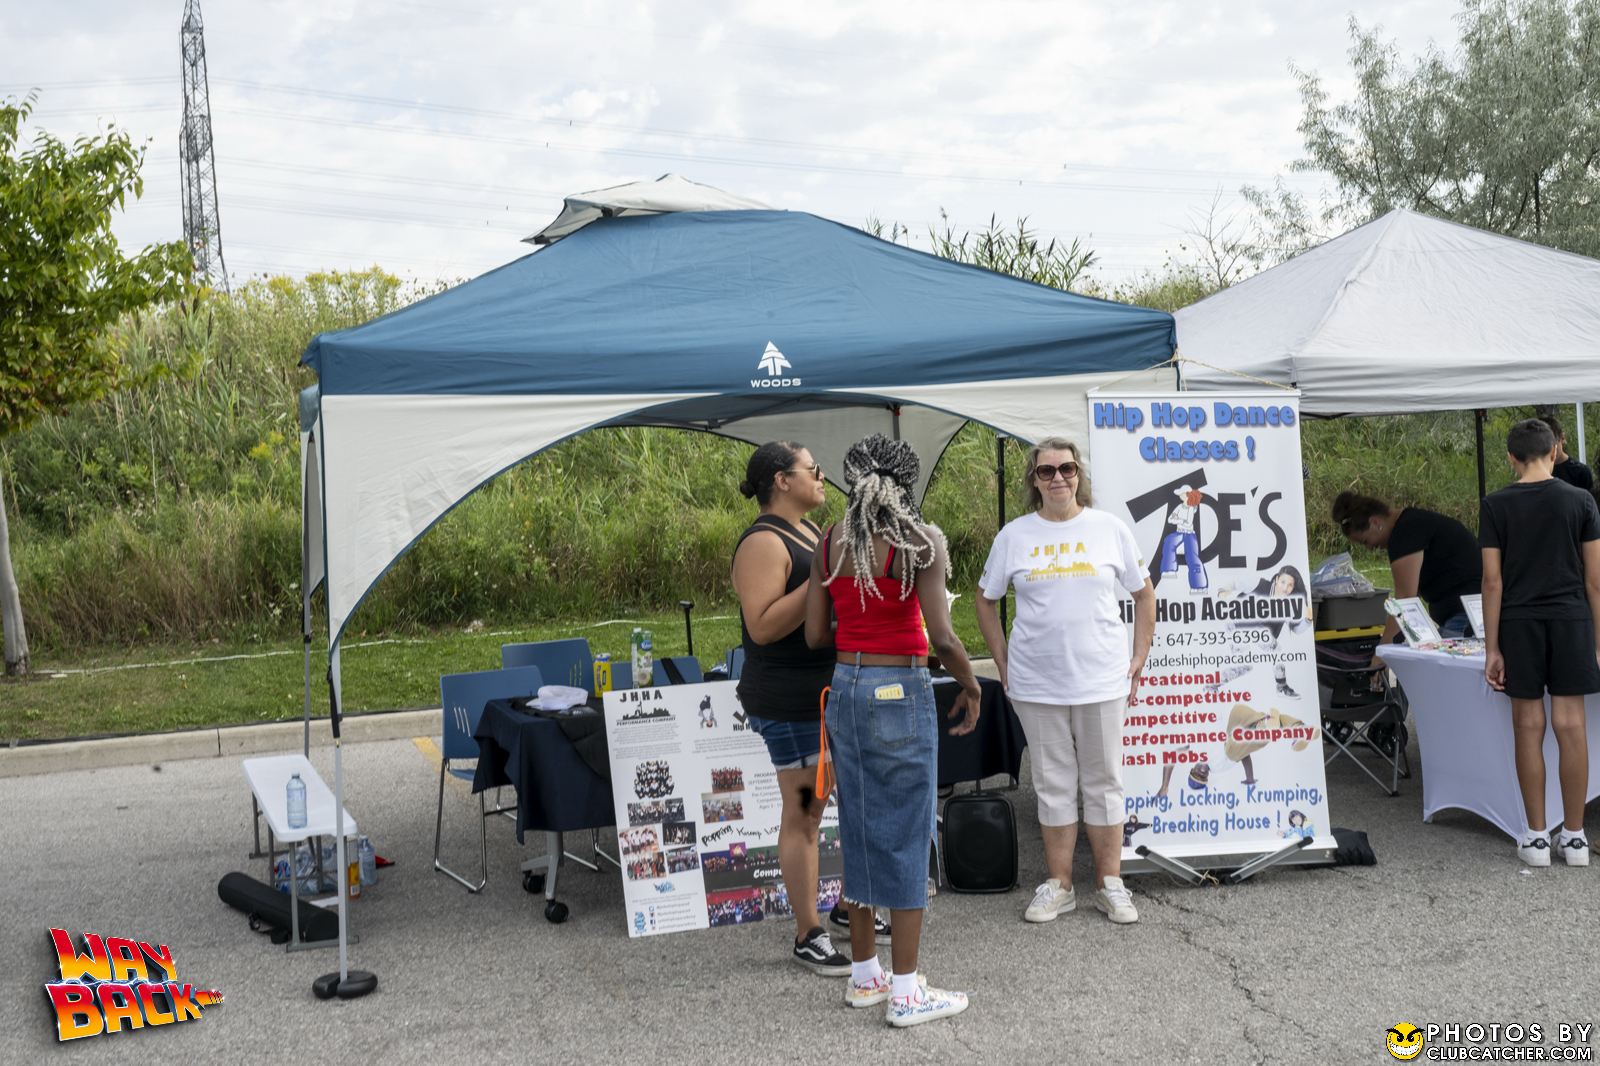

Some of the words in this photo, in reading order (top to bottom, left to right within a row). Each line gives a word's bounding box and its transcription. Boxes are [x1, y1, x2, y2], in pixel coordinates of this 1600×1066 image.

[751, 378, 801, 388] WOODS
[1093, 402, 1143, 432] Hip
[1151, 402, 1207, 432] Hop
[1213, 402, 1296, 427] Dance
[1139, 436, 1239, 462] Classes
[1156, 598, 1196, 624] Hop
[1201, 595, 1303, 621] Academy
[1166, 629, 1270, 647] 647-393-6396
[1146, 650, 1307, 670] .jadeshiphopacademy.com
[1139, 671, 1221, 687] reational
[1131, 690, 1252, 707] e-competitive
[1122, 731, 1227, 746] erformance
[1232, 727, 1315, 742] Company
[1162, 750, 1208, 765] Mobs
[1125, 790, 1173, 815] pping,
[1180, 787, 1240, 809] Locking,
[1246, 783, 1323, 806] Krumping,
[1152, 811, 1219, 836] Breaking
[1225, 812, 1271, 831] House
